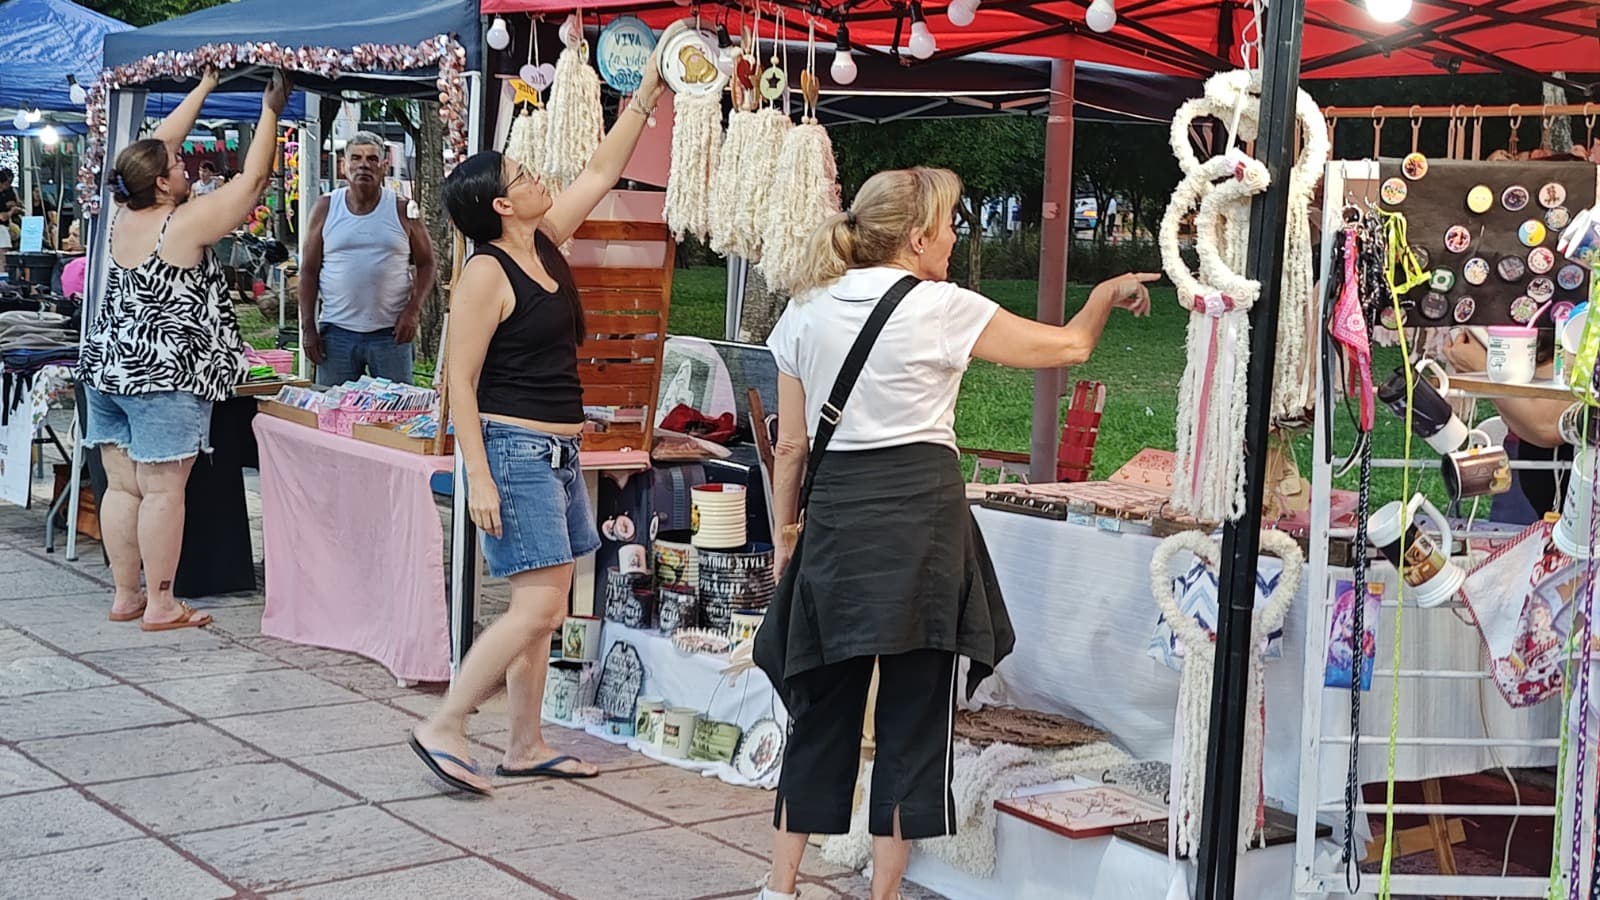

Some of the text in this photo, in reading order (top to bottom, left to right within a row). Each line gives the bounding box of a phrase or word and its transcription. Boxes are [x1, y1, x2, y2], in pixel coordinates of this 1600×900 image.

[614, 33, 642, 46] VIVA
[625, 50, 647, 66] vida
[735, 556, 766, 569] STYLE
